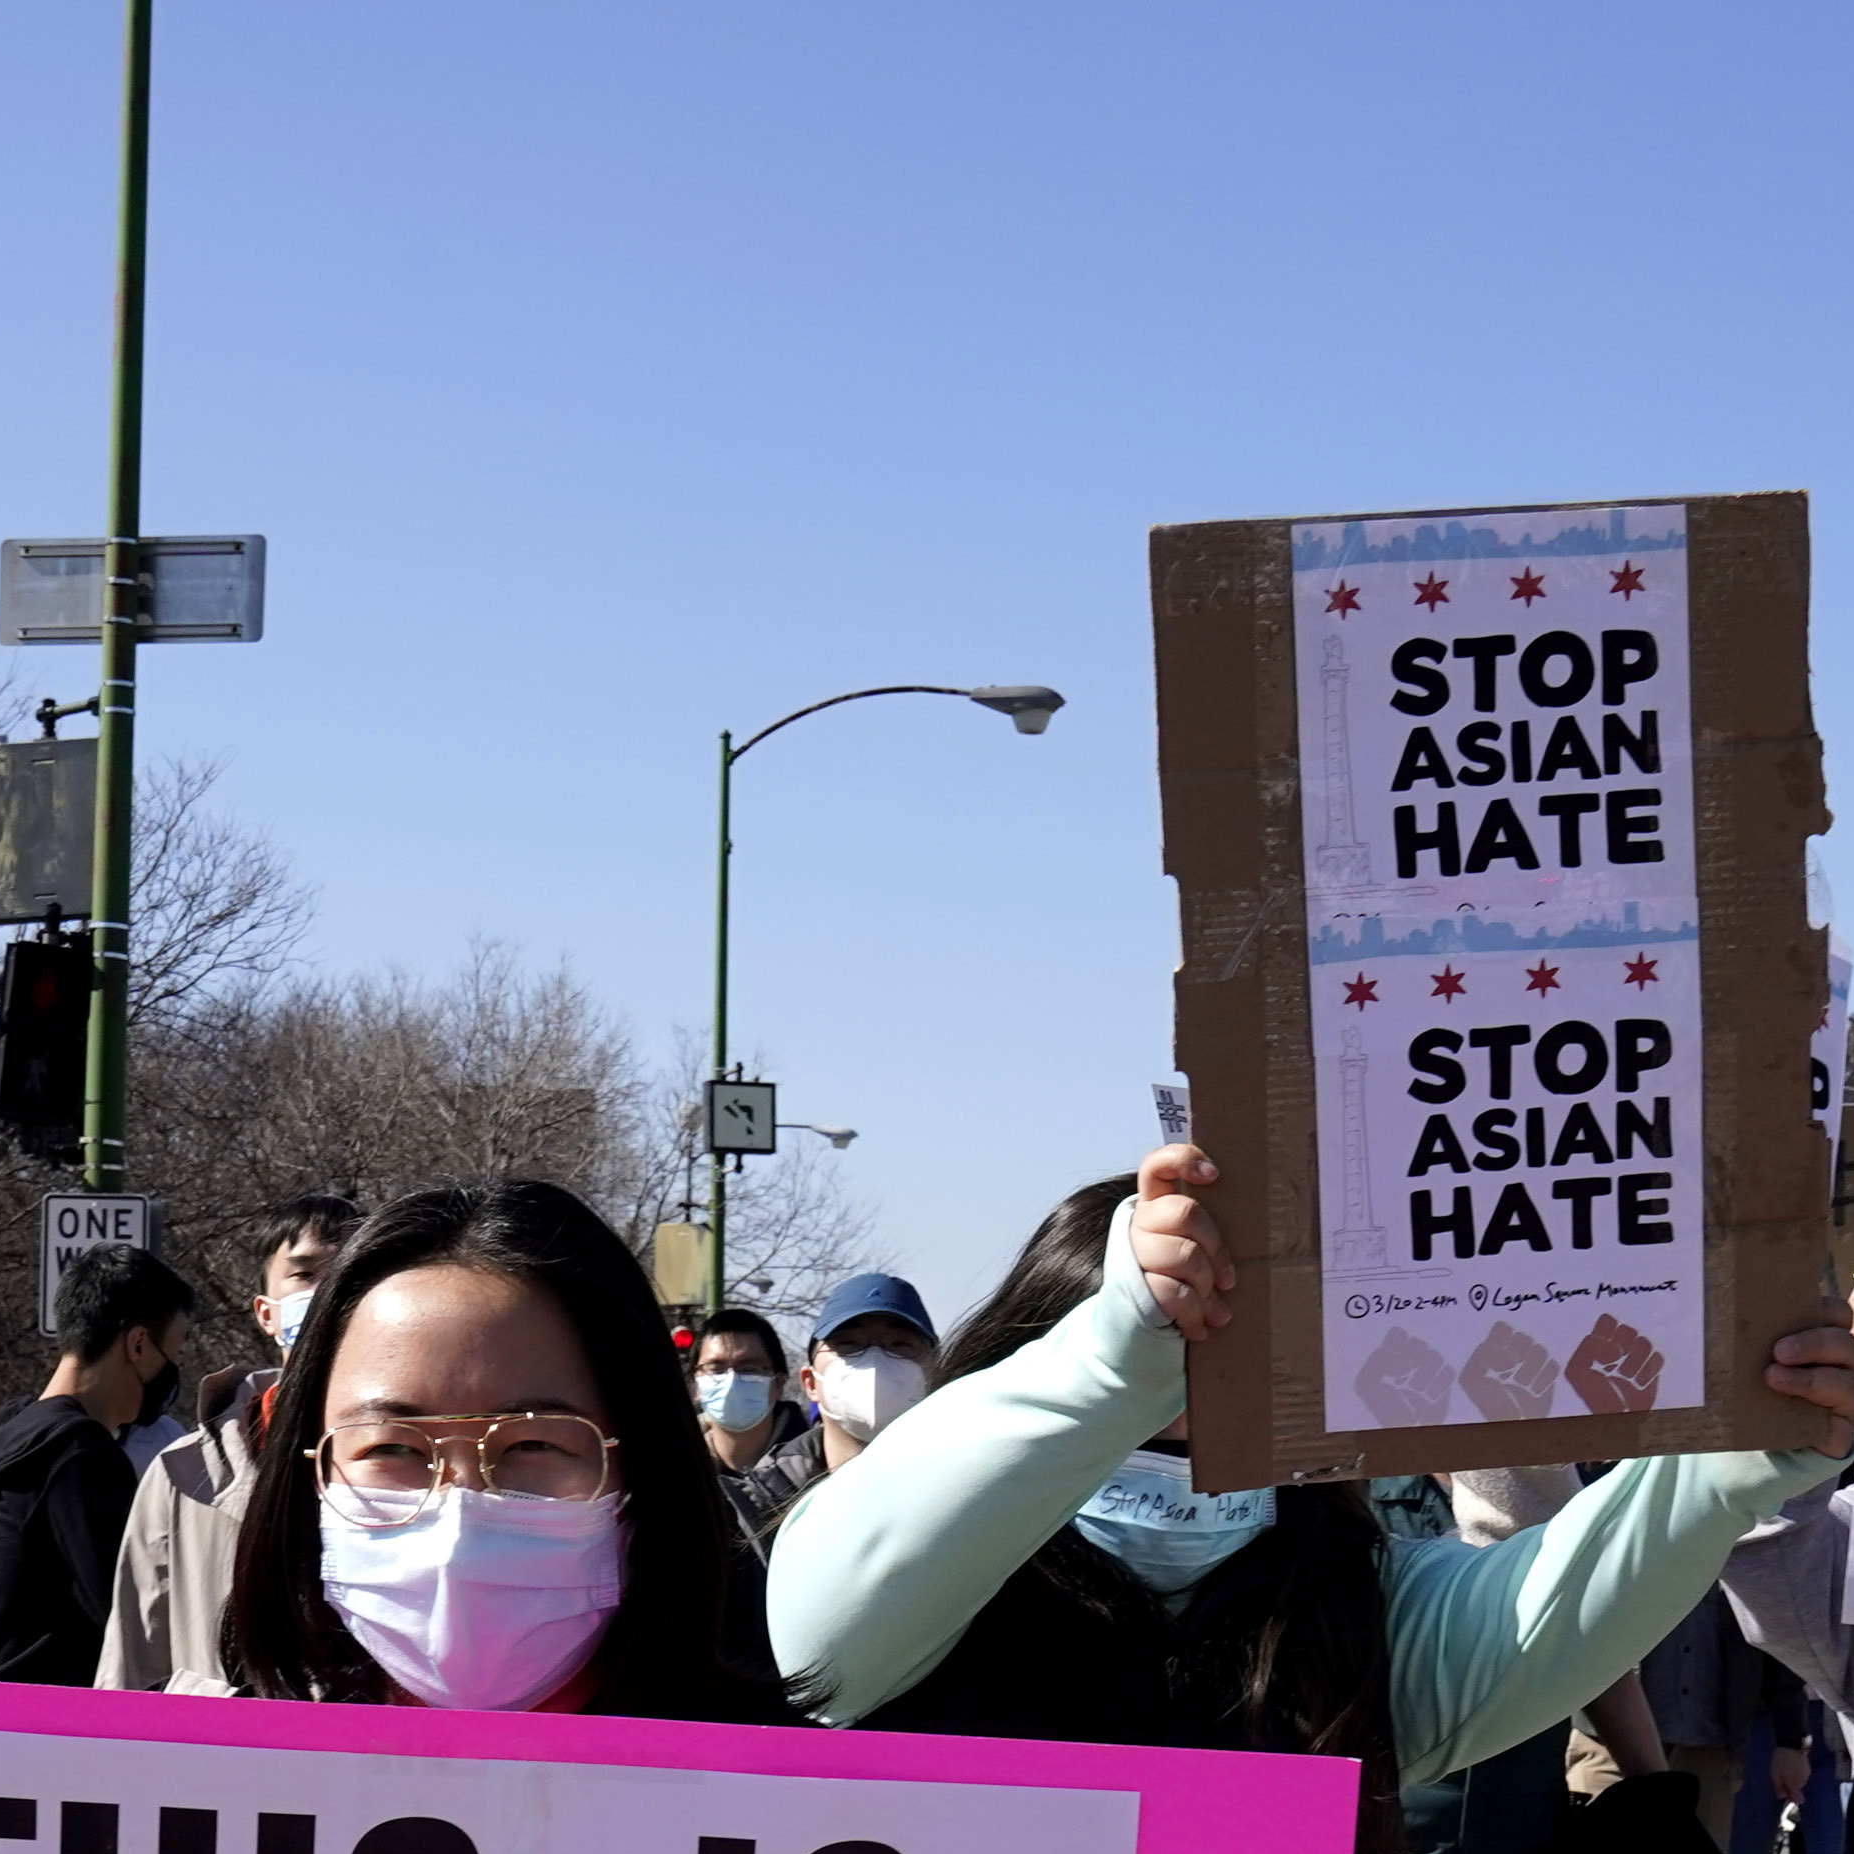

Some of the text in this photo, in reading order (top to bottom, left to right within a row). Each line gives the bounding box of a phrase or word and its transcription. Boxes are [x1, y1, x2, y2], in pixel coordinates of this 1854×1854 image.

[1390, 629, 1659, 717] STOP
[1390, 710, 1663, 793] ASIAN
[1391, 787, 1665, 880] HATE
[1407, 1018, 1673, 1106] STOP
[1407, 1096, 1674, 1179] ASIAN
[58, 1206, 133, 1240] ONE
[1409, 1171, 1675, 1261] HATE
